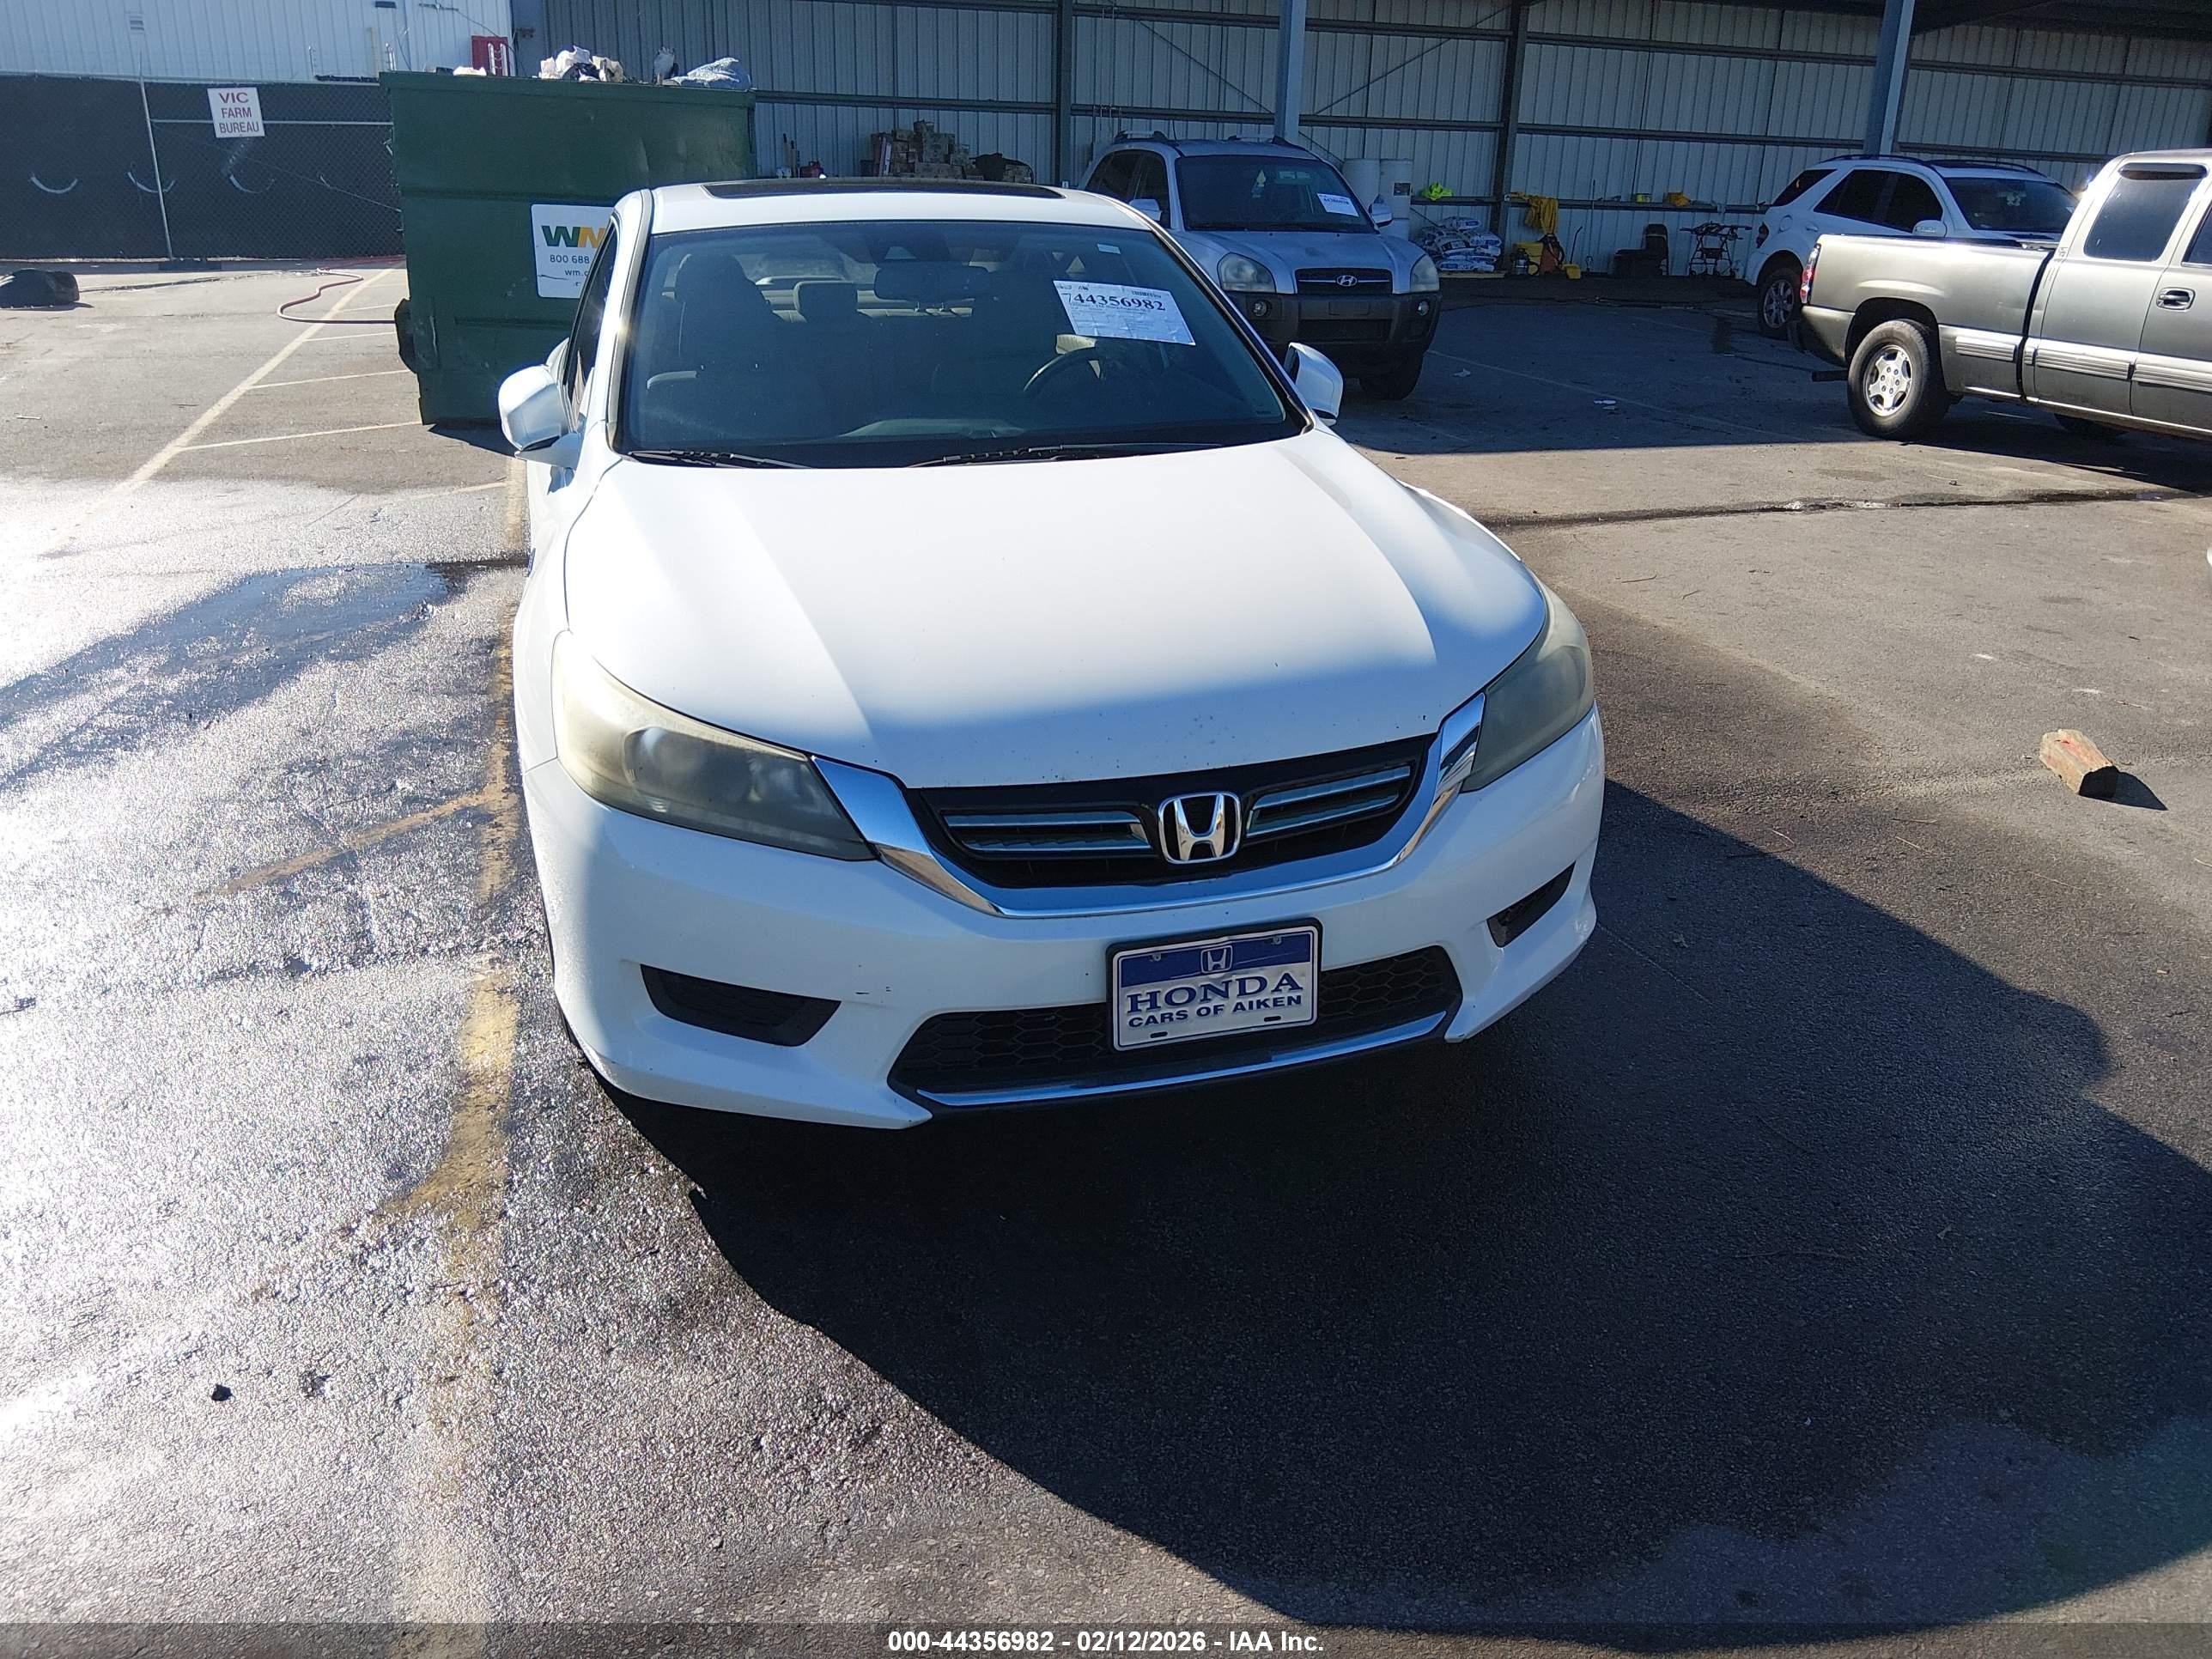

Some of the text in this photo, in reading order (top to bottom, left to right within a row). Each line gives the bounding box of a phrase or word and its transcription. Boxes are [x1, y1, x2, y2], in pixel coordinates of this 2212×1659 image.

[219, 92, 249, 103] VIC
[221, 106, 252, 118] FARM
[219, 122, 259, 133] BUREAU
[550, 254, 590, 264] 800 688
[1127, 972, 1304, 1014] HONDA
[1128, 995, 1302, 1028] CARS OF AIKEN
